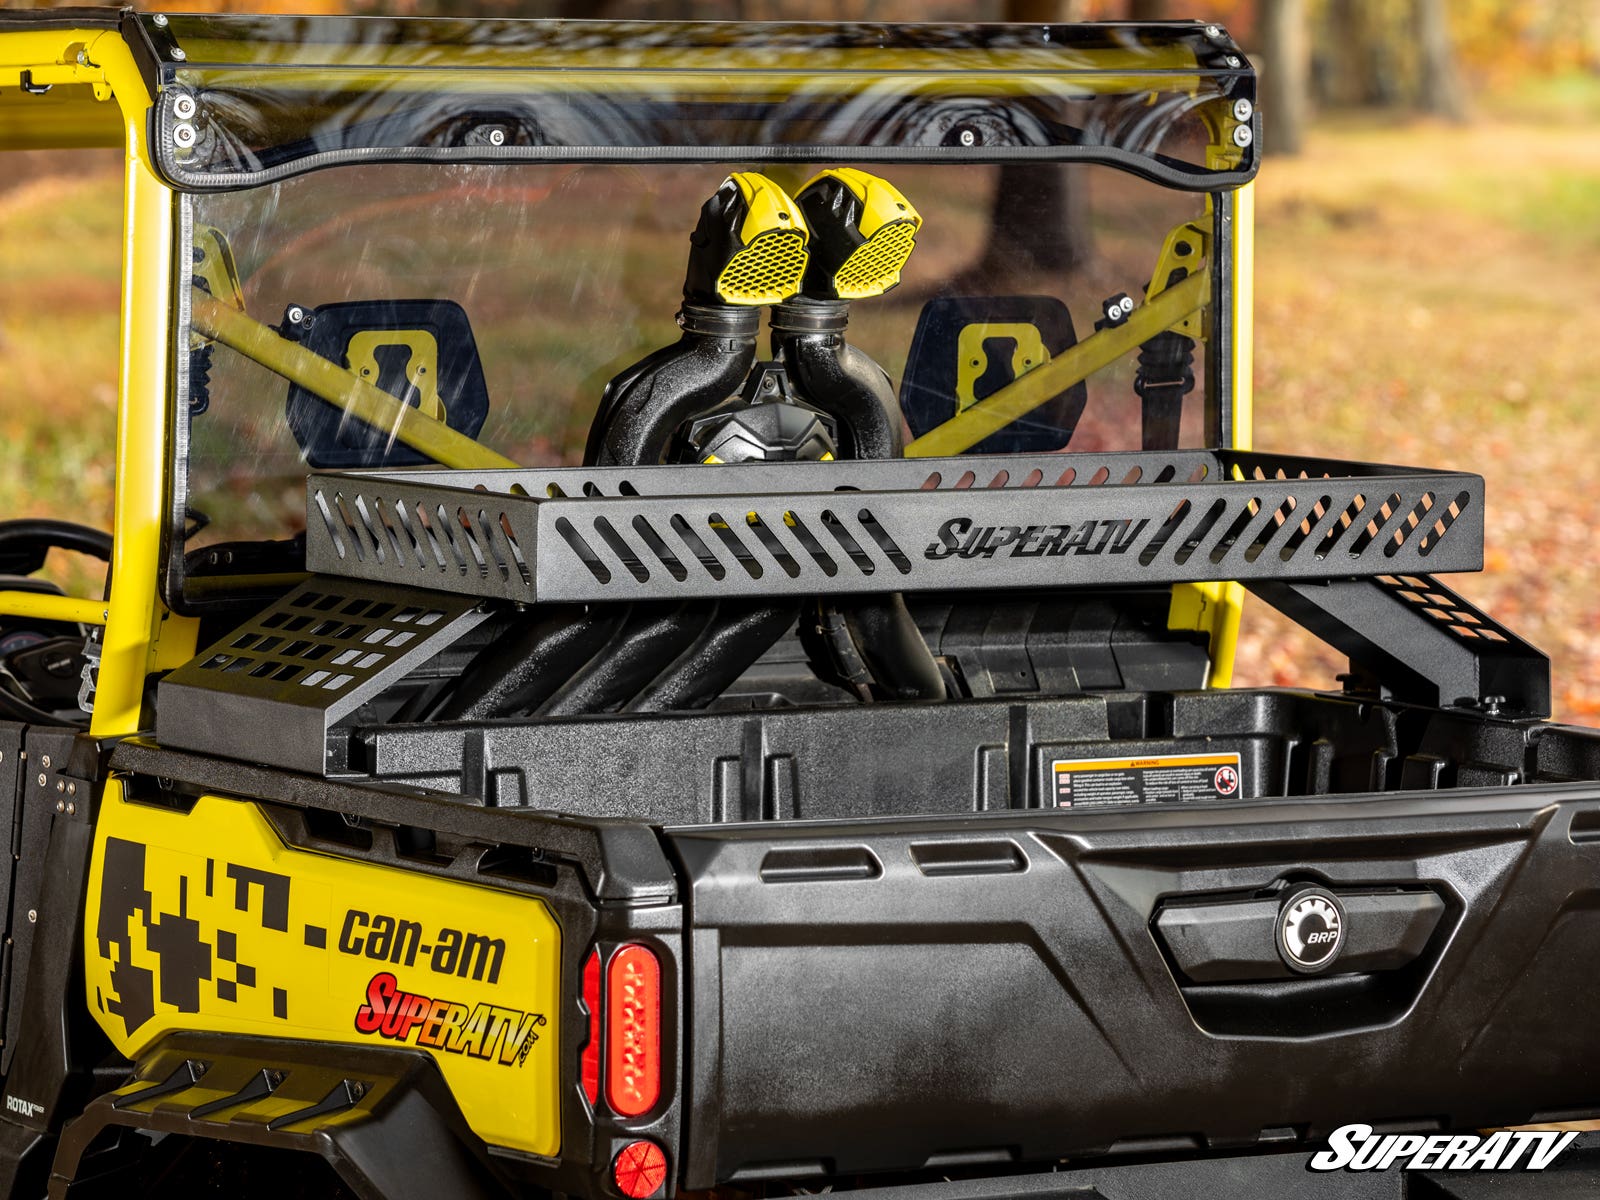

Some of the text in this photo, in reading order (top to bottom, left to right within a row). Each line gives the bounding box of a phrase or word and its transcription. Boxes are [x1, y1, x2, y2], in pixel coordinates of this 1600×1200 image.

[924, 517, 1150, 560] SUPERATV
[338, 908, 506, 985] can-am
[1307, 931, 1338, 944] BRP
[354, 971, 544, 1068] SUPERATV
[6, 1094, 33, 1118] ROTAX
